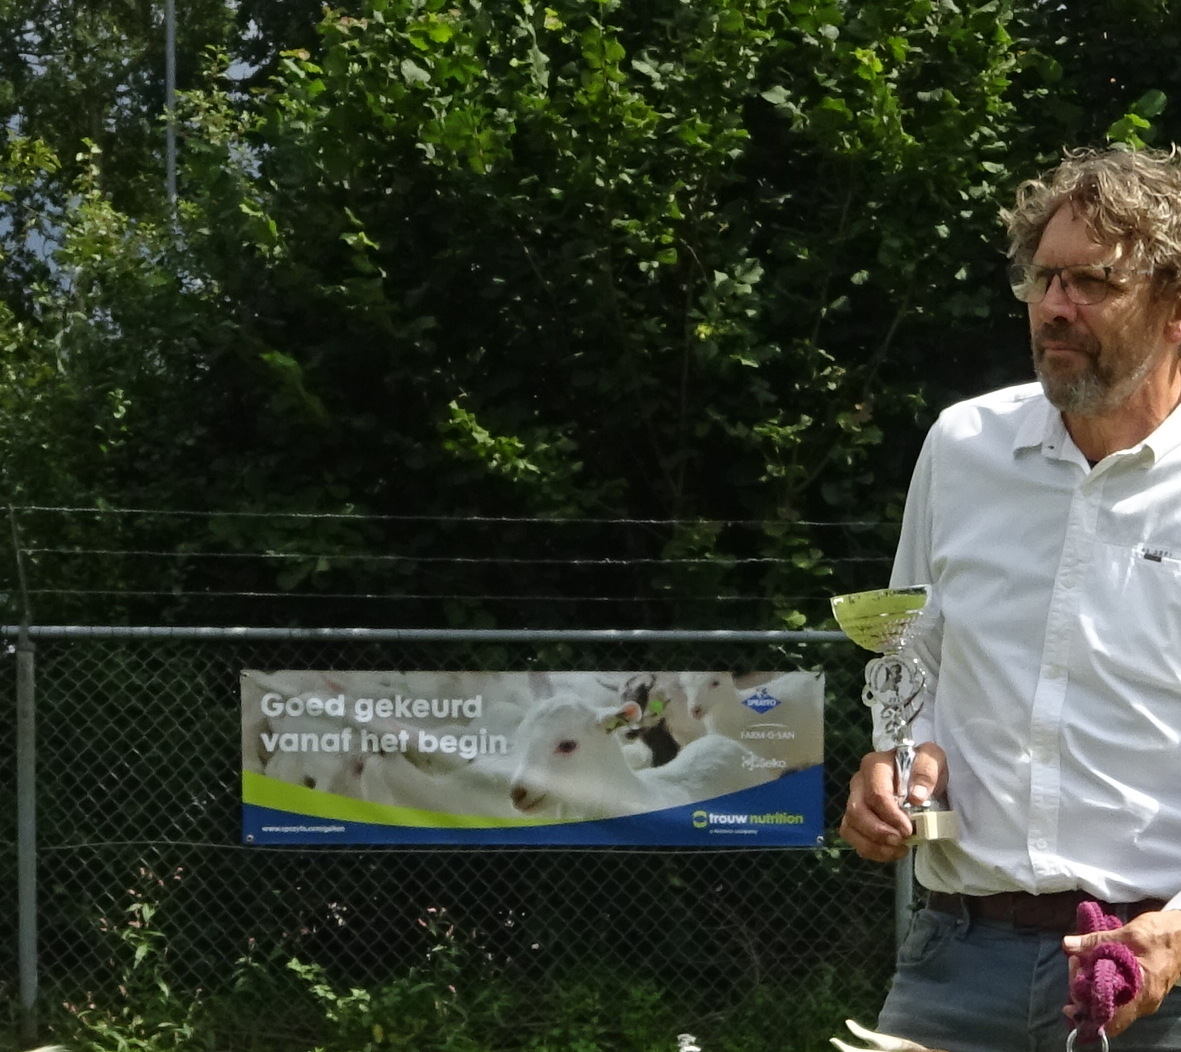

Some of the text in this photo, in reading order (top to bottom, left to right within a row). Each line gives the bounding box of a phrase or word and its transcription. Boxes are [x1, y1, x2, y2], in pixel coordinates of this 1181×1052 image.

[261, 693, 483, 723] Goed gekeurd
[260, 728, 507, 760] vanaf het begin
[709, 812, 804, 824] trouw nutrition
